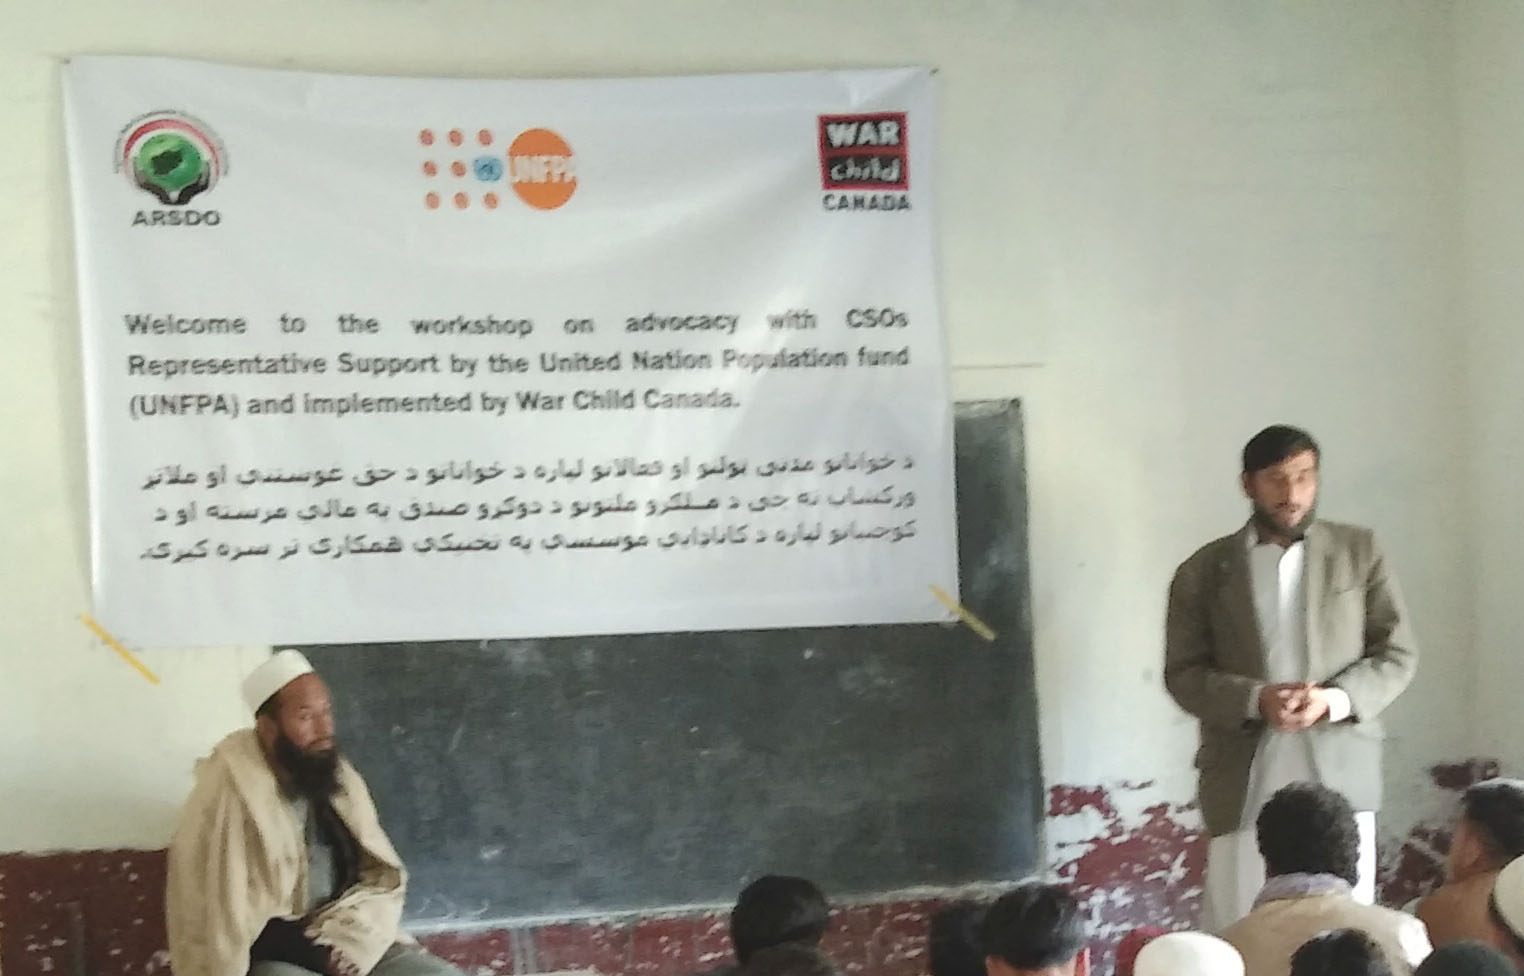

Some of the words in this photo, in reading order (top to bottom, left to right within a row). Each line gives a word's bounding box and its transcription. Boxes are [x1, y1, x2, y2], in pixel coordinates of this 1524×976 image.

[825, 120, 900, 148] WAR
[829, 157, 901, 182] child
[823, 193, 911, 212] CANADA
[131, 209, 222, 227] ARSDO
[124, 313, 247, 335] Welcome
[279, 313, 307, 335] to
[337, 312, 381, 335] the
[410, 313, 533, 338] workshop
[563, 317, 594, 334] on
[625, 312, 739, 335] advocacy
[766, 308, 818, 331] with
[844, 306, 910, 330] CSOs
[127, 352, 327, 380] Representative
[336, 351, 440, 378] Support
[449, 352, 478, 378] by
[487, 351, 529, 374] the
[539, 350, 621, 373] United
[631, 348, 712, 371] Nation
[721, 347, 848, 376] Population
[856, 345, 910, 368] fund
[128, 392, 241, 421] (UNFPA)
[247, 392, 295, 416] and
[302, 391, 473, 418] implemented
[480, 391, 508, 418] by
[514, 390, 566, 413] War
[571, 387, 637, 412] Child
[642, 386, 742, 411] Canada.
[513, 464, 527, 480] د
[671, 455, 690, 481] او
[903, 454, 913, 469] د
[206, 462, 227, 489] او
[404, 465, 418, 481] د
[154, 506, 168, 522] د
[174, 500, 198, 527] او
[727, 496, 741, 510] د
[754, 526, 768, 544] د
